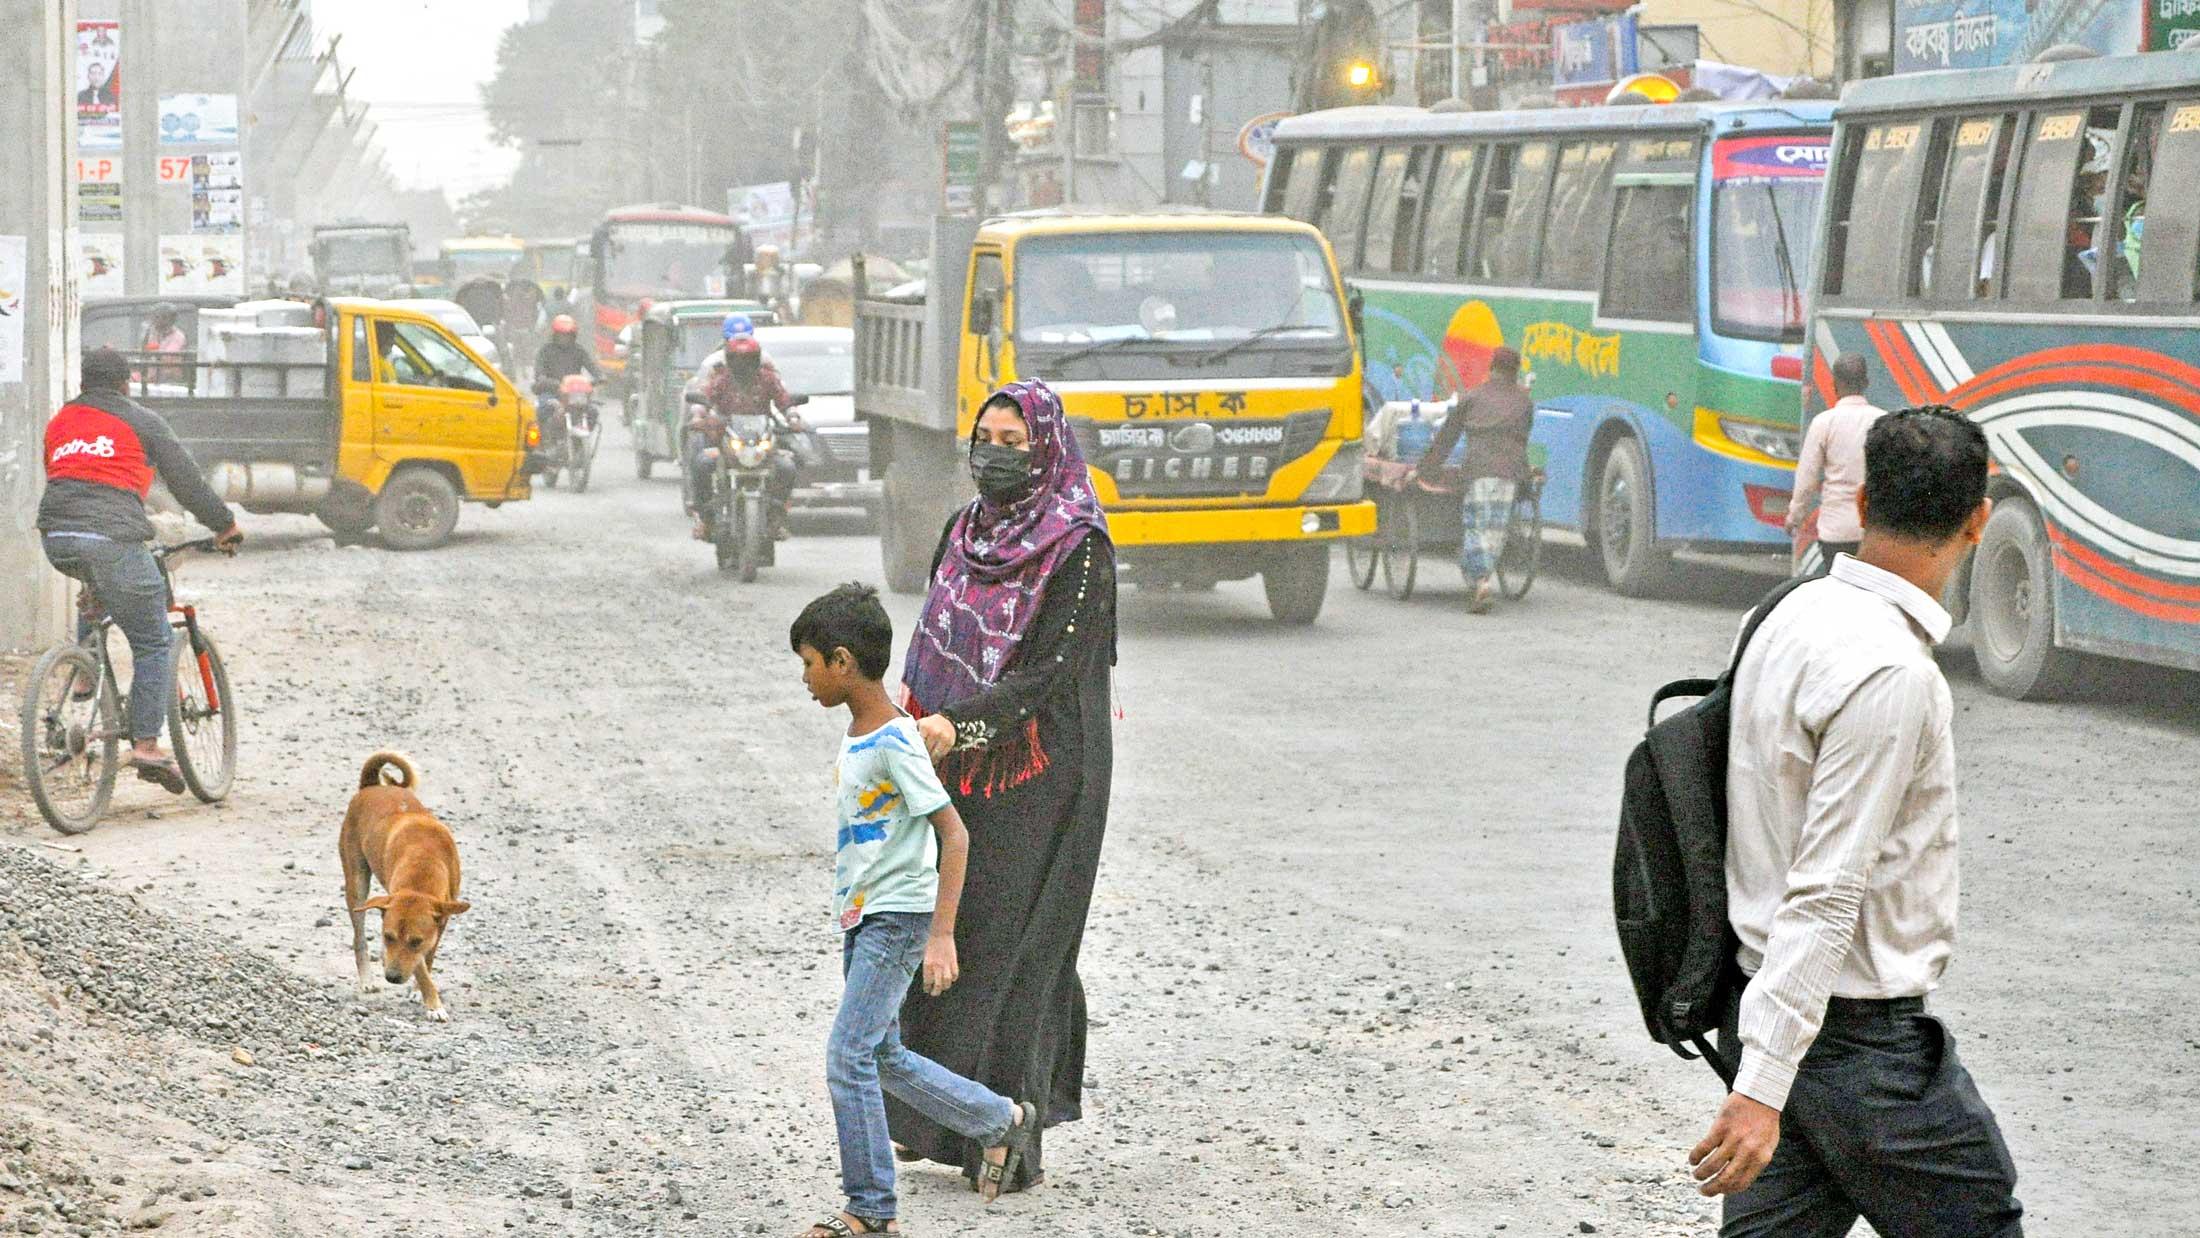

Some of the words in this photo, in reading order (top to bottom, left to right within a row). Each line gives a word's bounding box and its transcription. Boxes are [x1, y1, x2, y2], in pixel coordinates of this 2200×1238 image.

[1904, 22, 1950, 66] বঙ্গবন্ধু
[1954, 9, 1997, 52] টানেল
[159, 158, 190, 180] 57
[1116, 456, 1268, 480] EICHER
